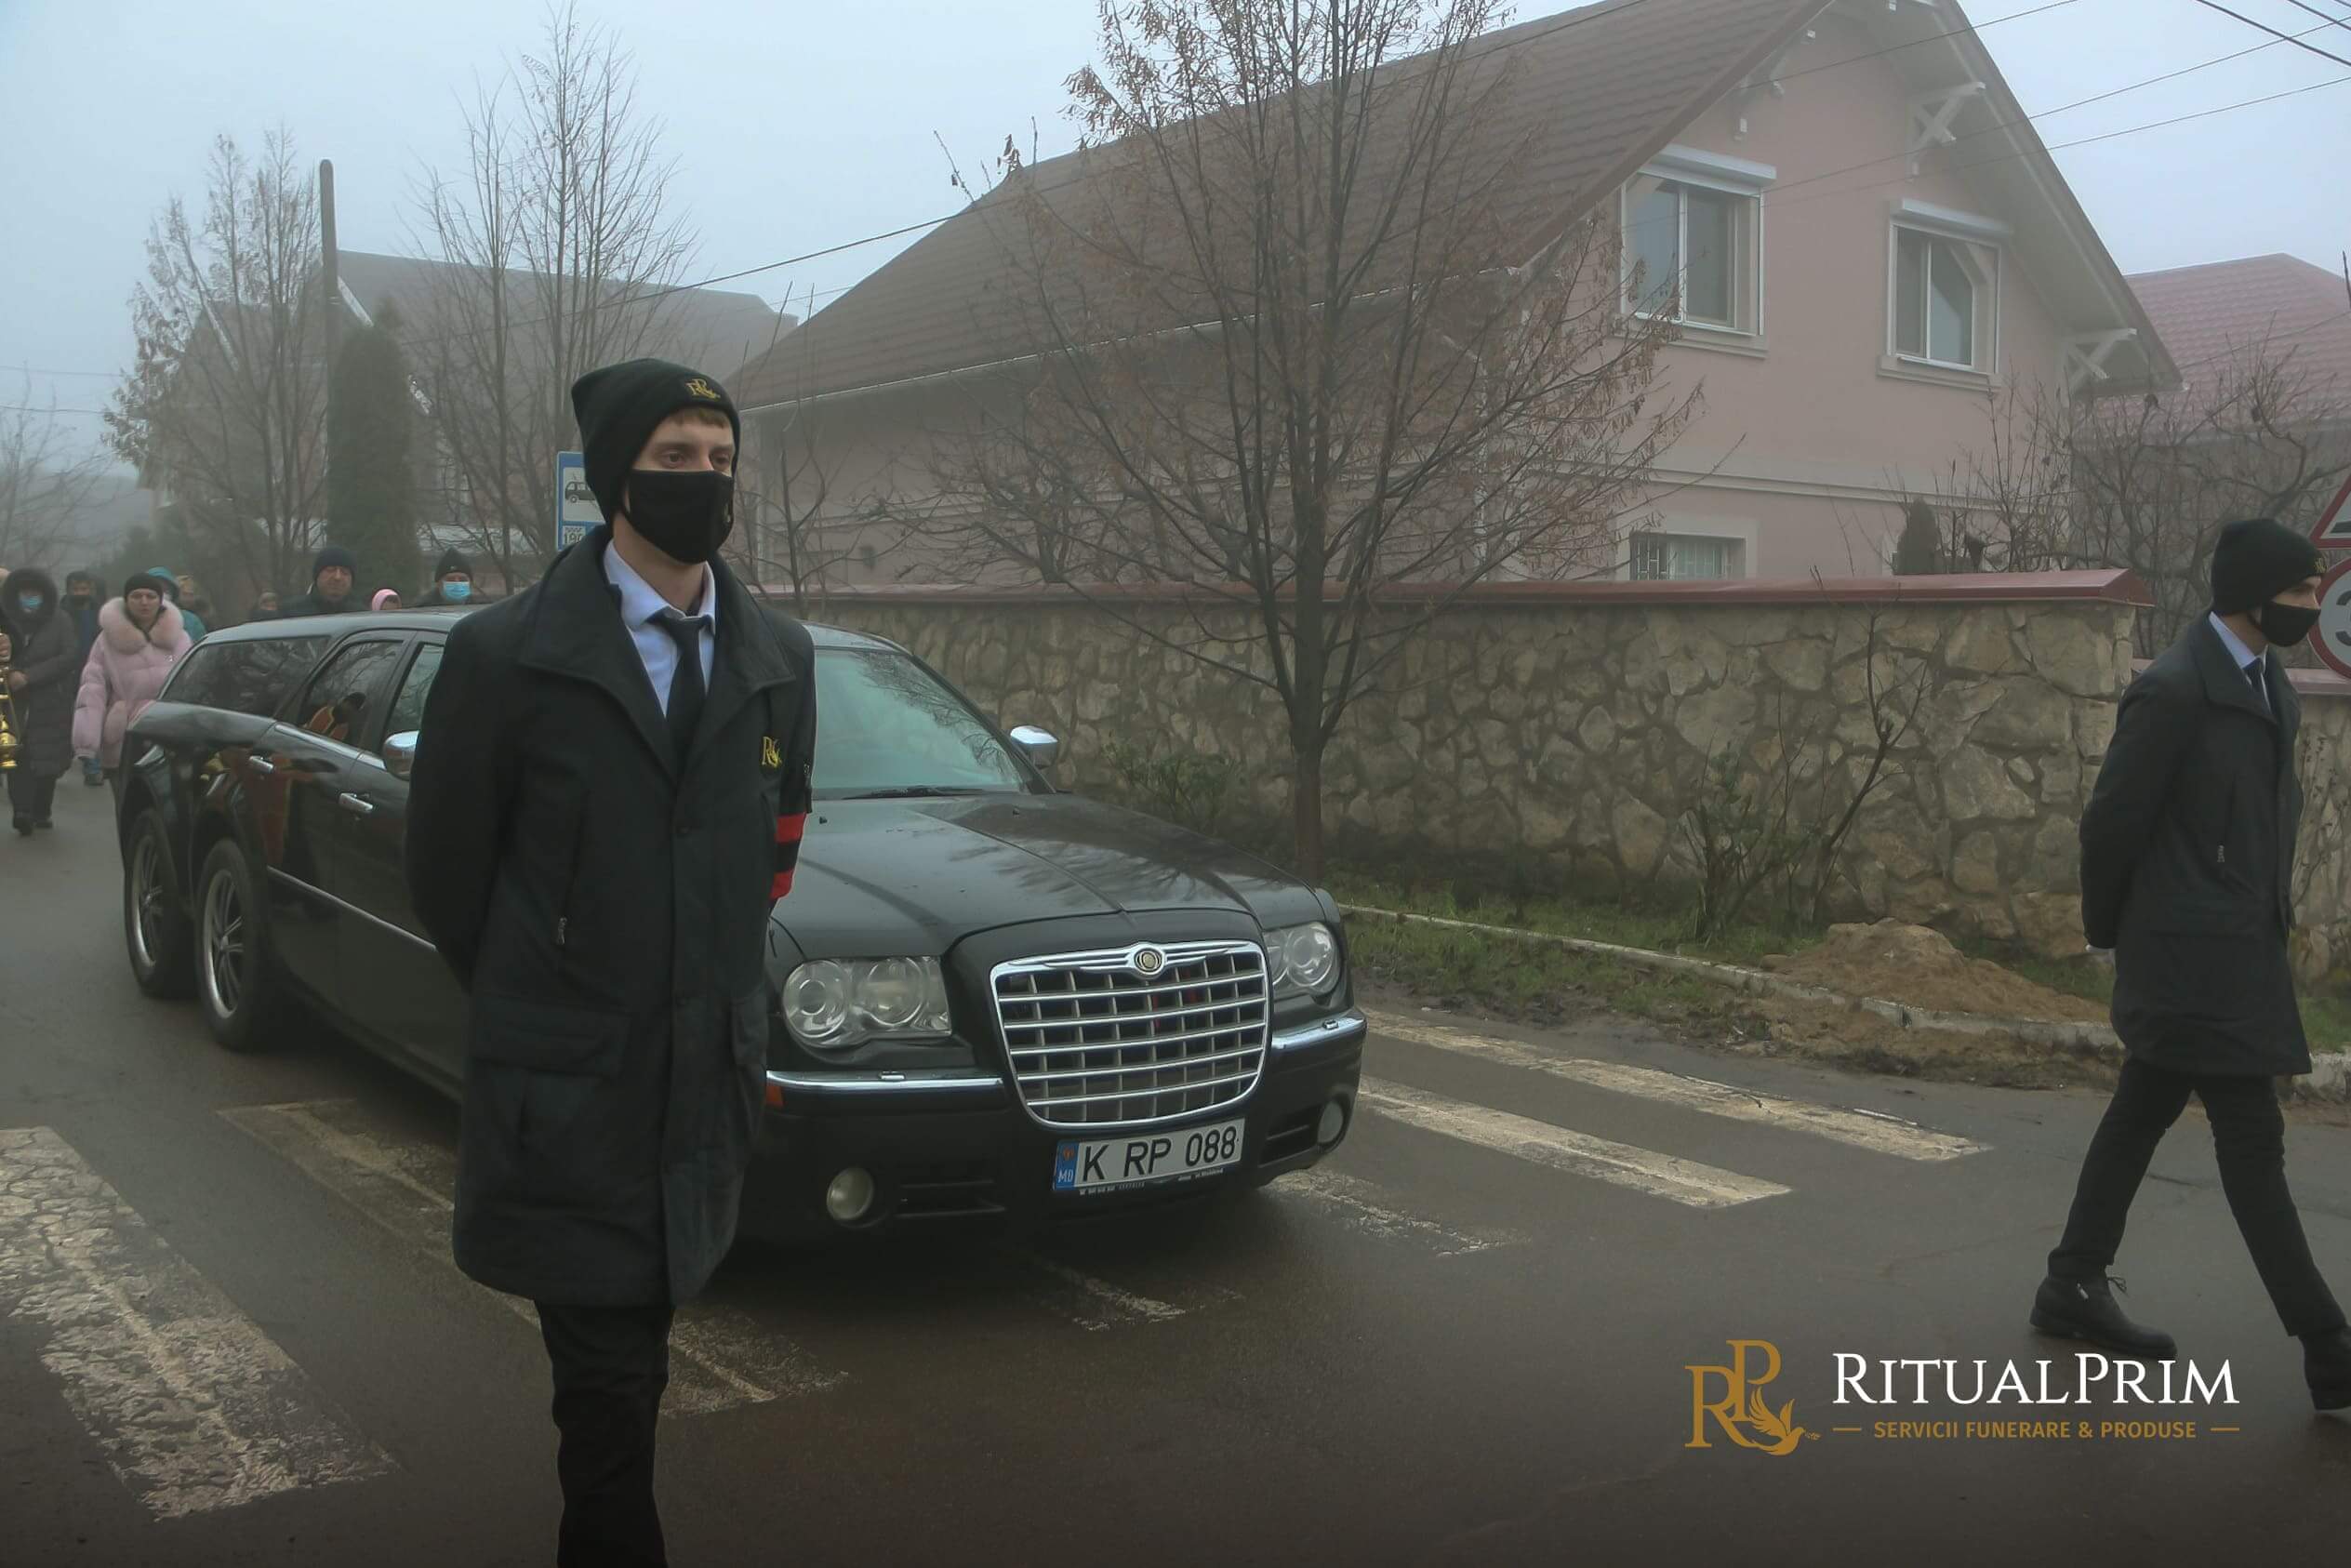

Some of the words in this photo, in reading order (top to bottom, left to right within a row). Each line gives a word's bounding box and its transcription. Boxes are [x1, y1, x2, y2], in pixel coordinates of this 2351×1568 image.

[1082, 1144, 1109, 1182] K
[1123, 1137, 1172, 1178] RP
[1185, 1125, 1237, 1168] 088
[1057, 1168, 1074, 1184] MD
